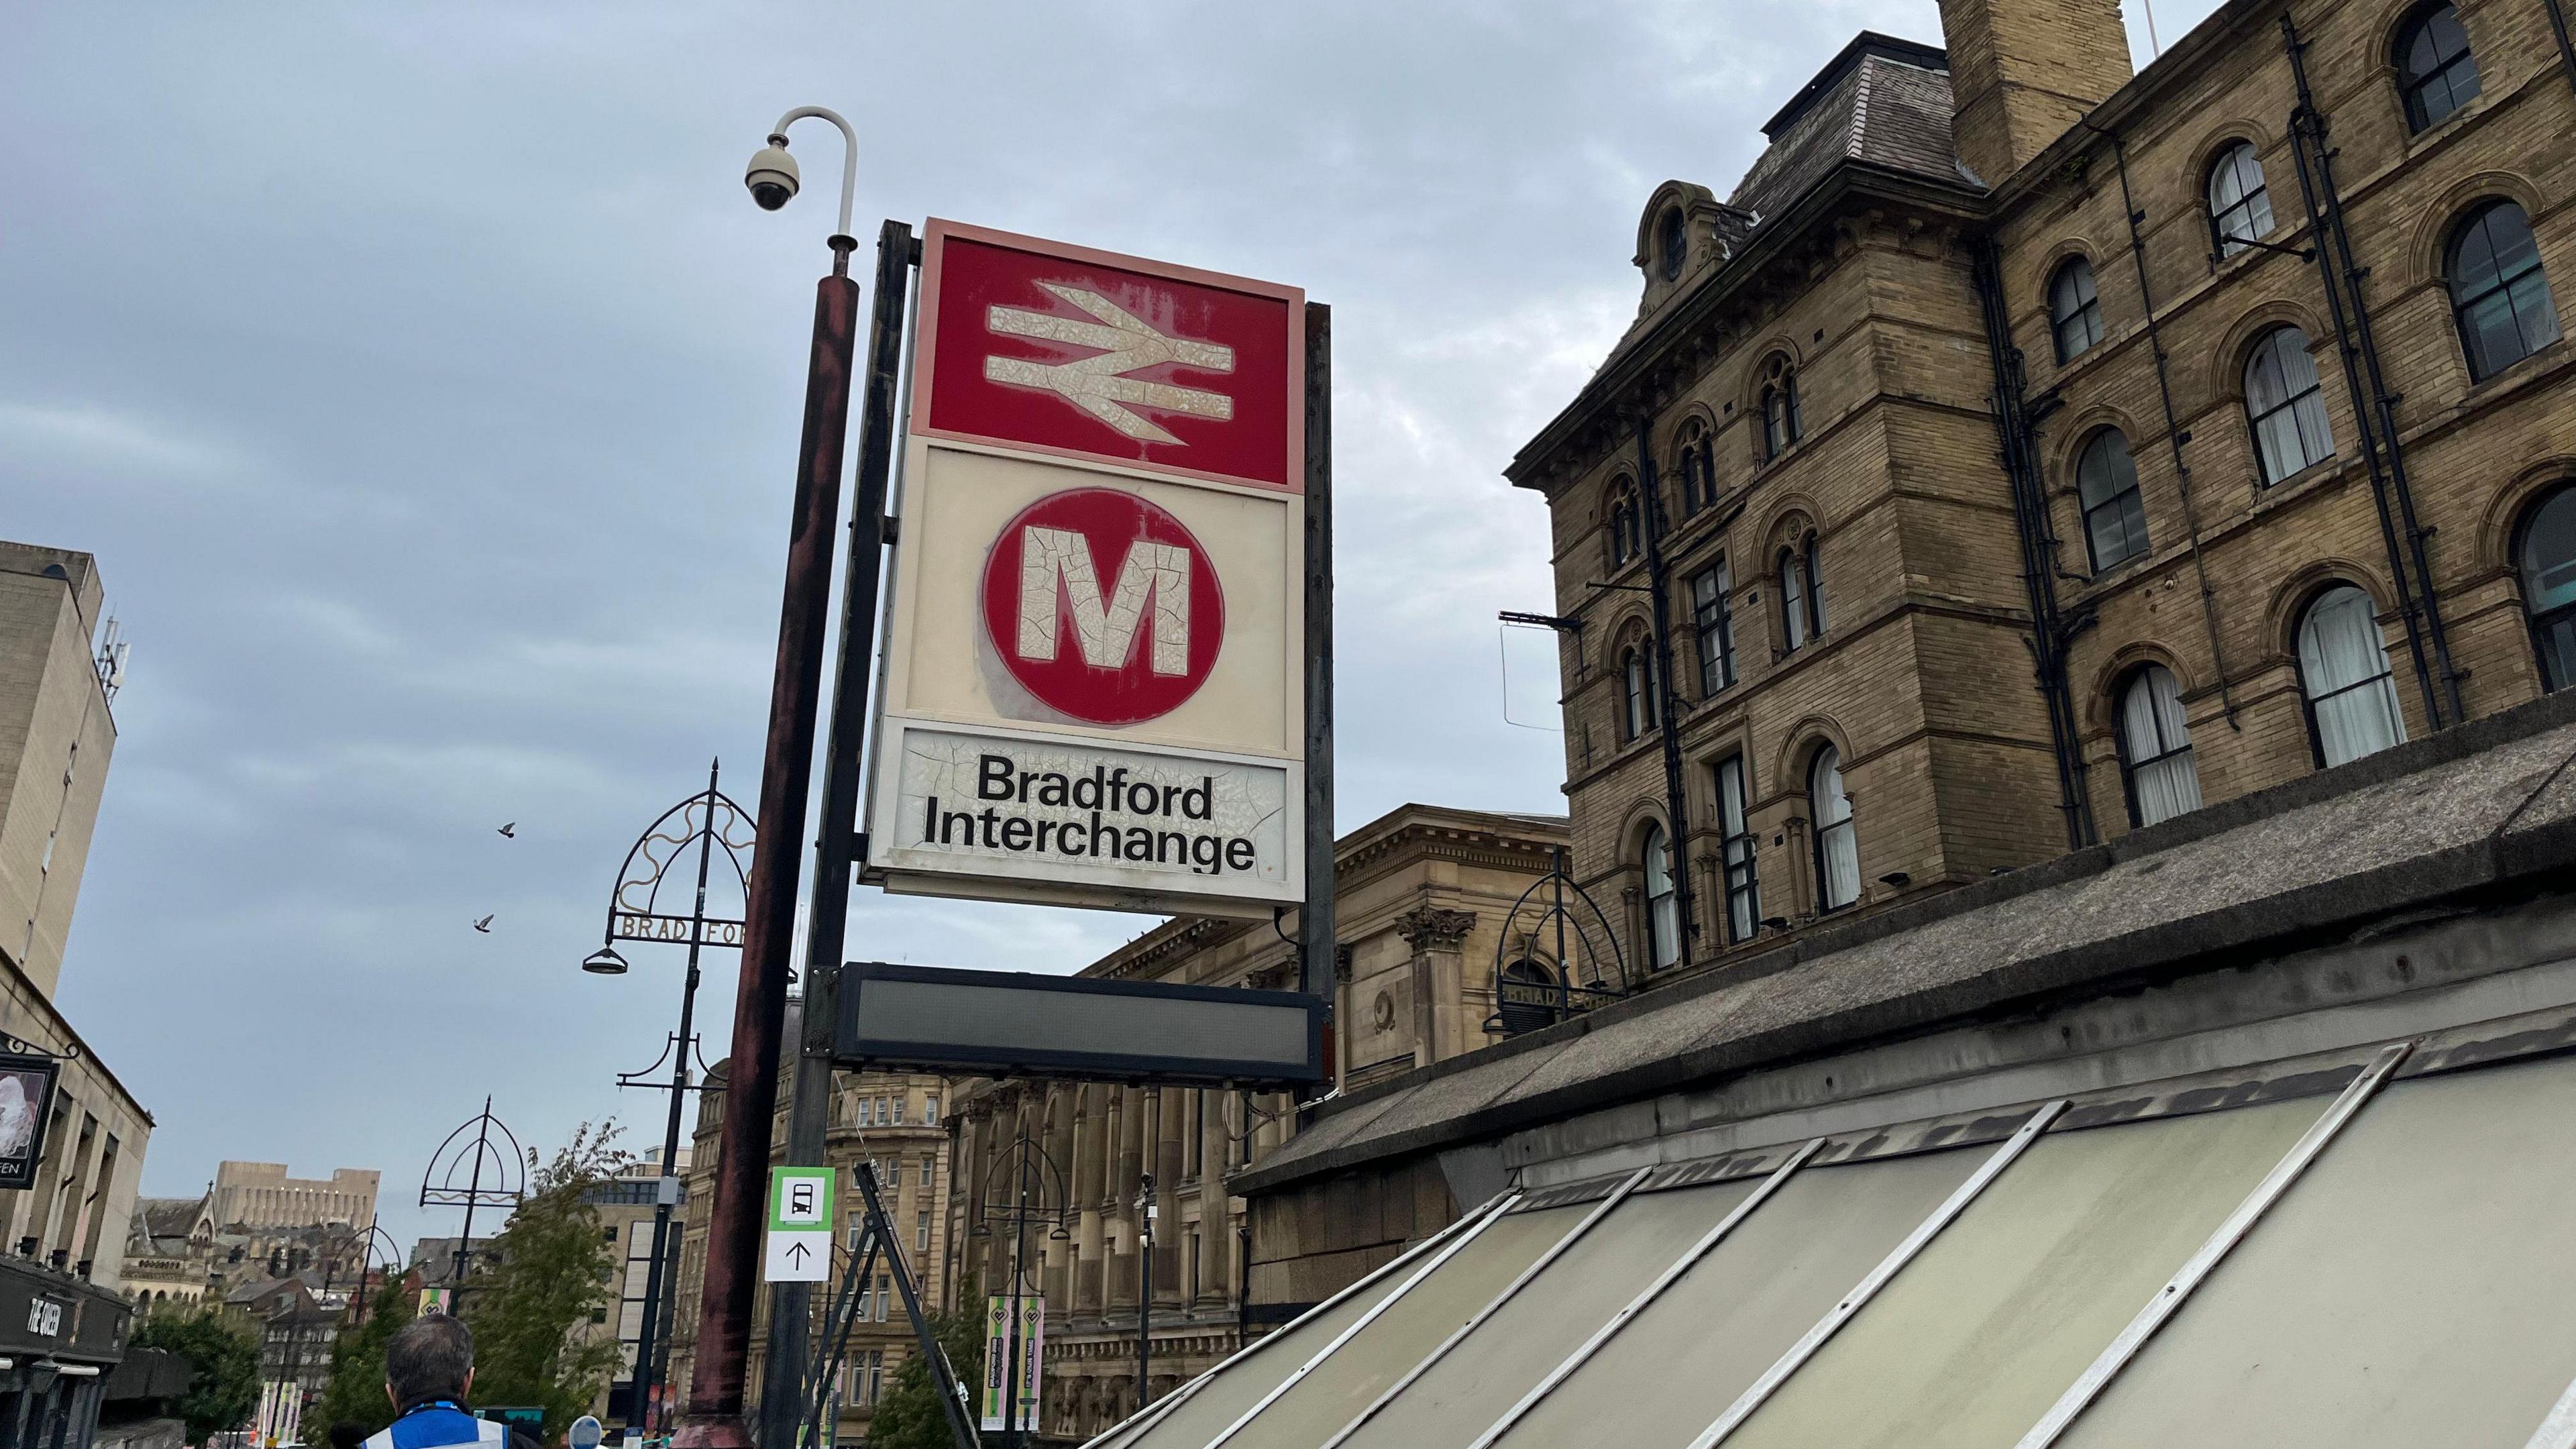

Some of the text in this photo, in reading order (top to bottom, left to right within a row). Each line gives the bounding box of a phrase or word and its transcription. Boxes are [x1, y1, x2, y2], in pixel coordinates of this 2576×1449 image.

[1018, 525, 1191, 676] M
[977, 754, 1212, 820] Bradford
[924, 796, 1255, 875] Interchange
[622, 915, 687, 941] BRAD
